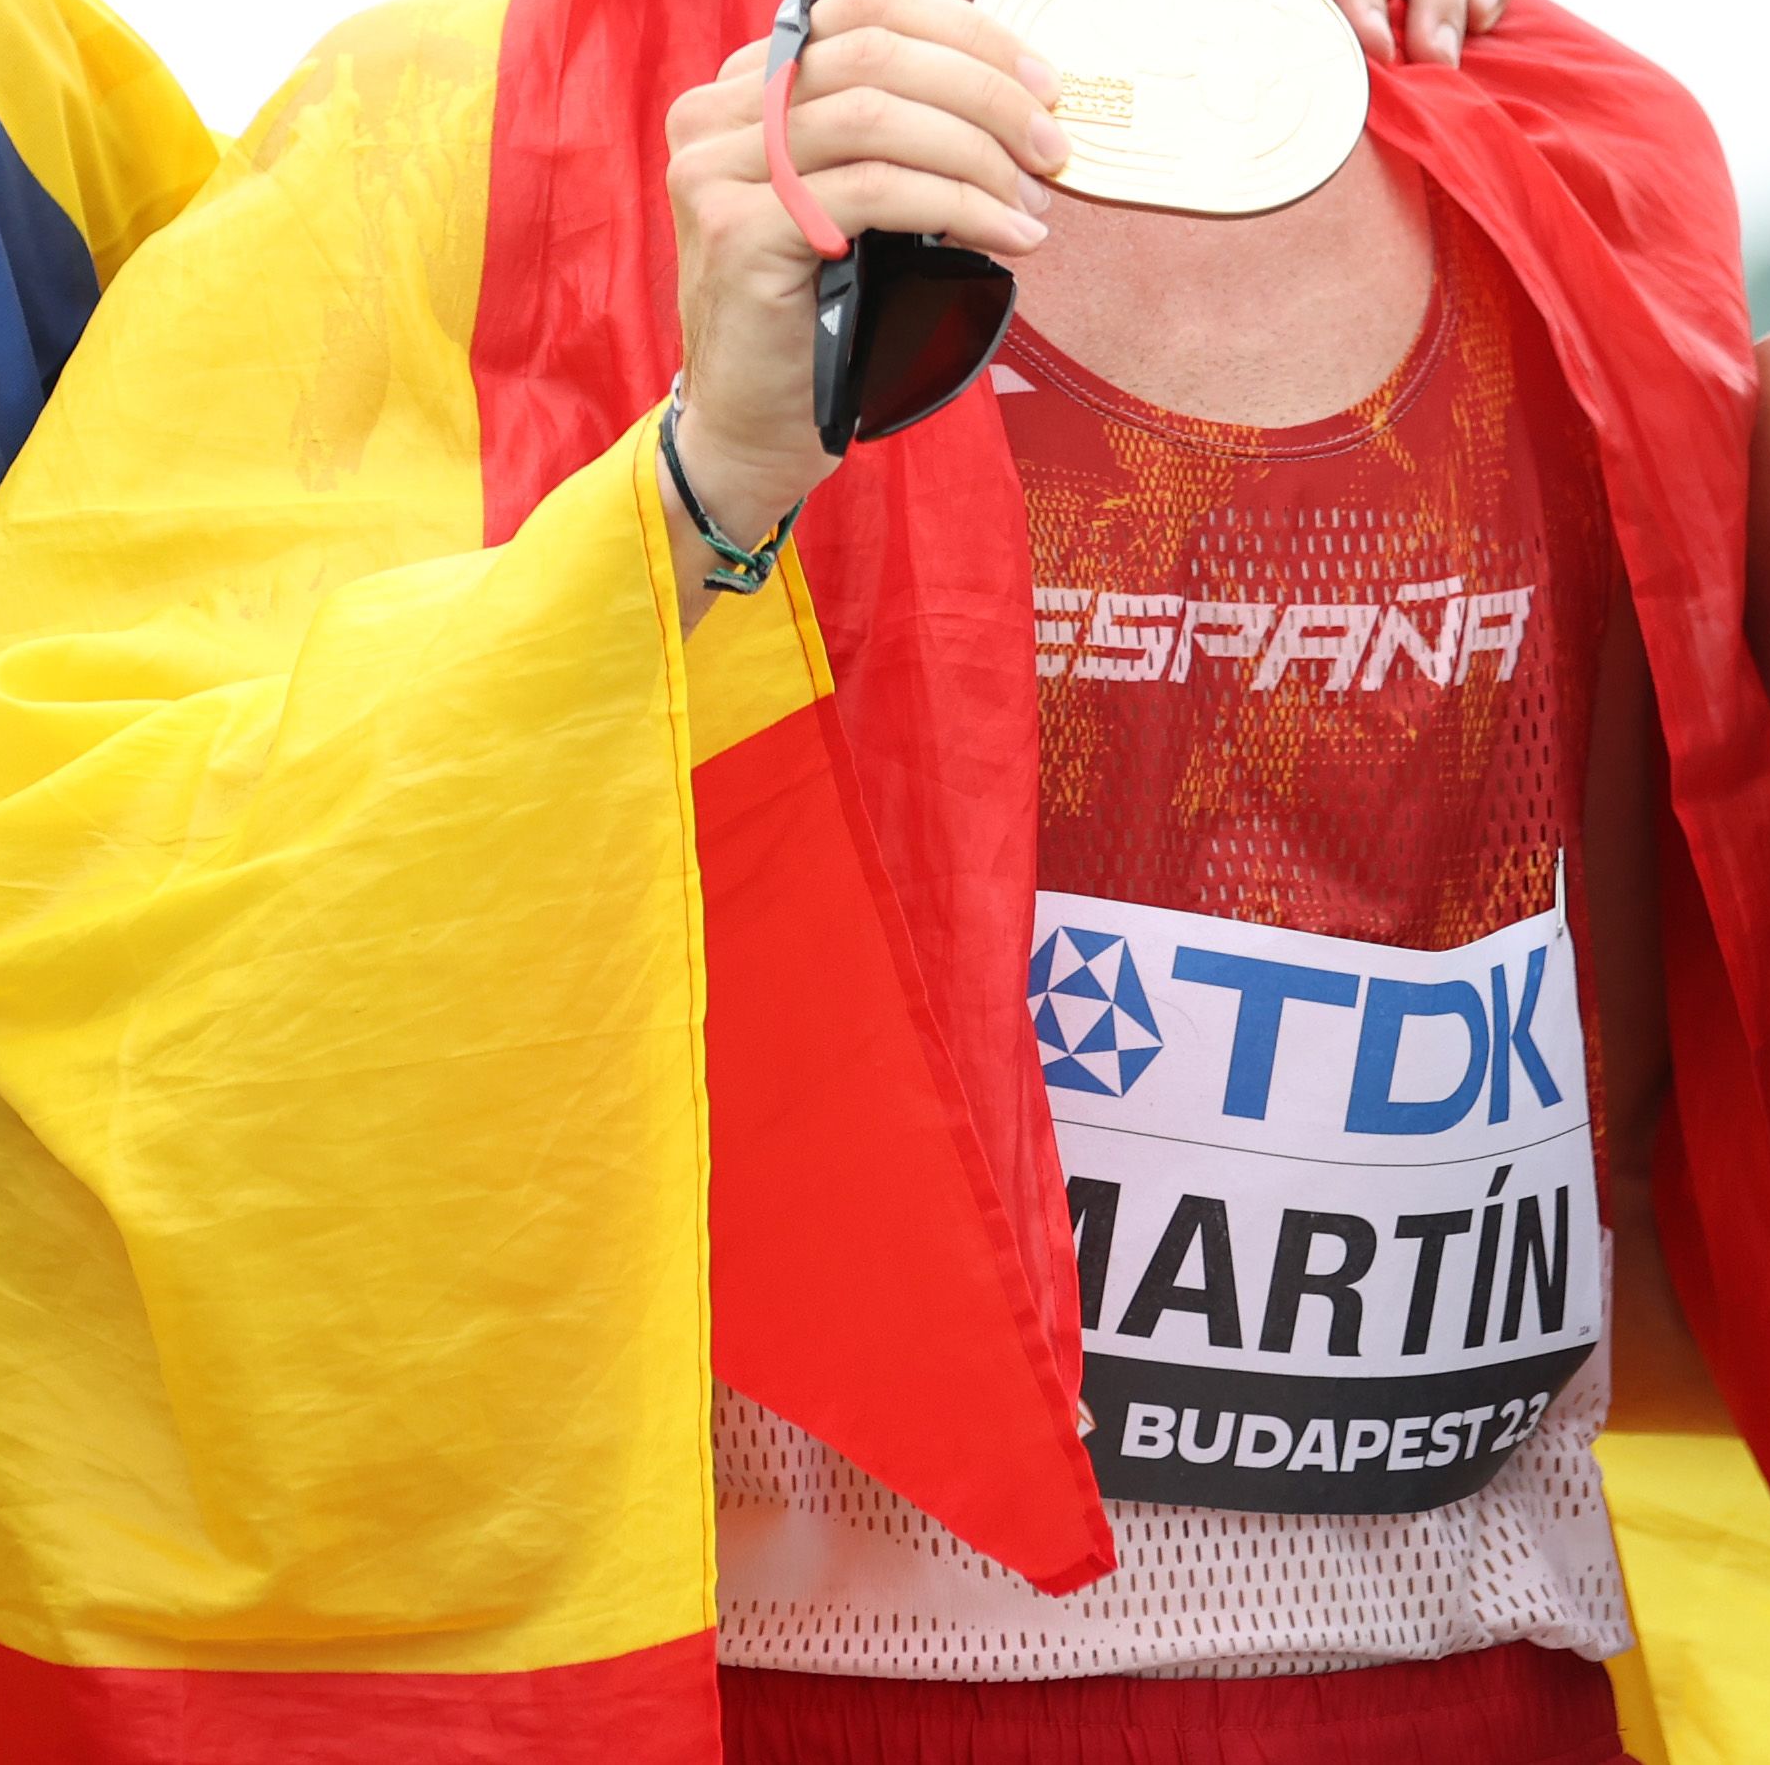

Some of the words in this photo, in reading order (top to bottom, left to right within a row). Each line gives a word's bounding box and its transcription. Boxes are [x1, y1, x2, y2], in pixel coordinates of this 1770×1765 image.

[1033, 576, 1535, 691] ESPAÑA
[1172, 945, 1562, 1135] TDK
[1120, 1401, 1495, 1473] BUDAPEST
[1489, 1391, 1550, 1453] 23
